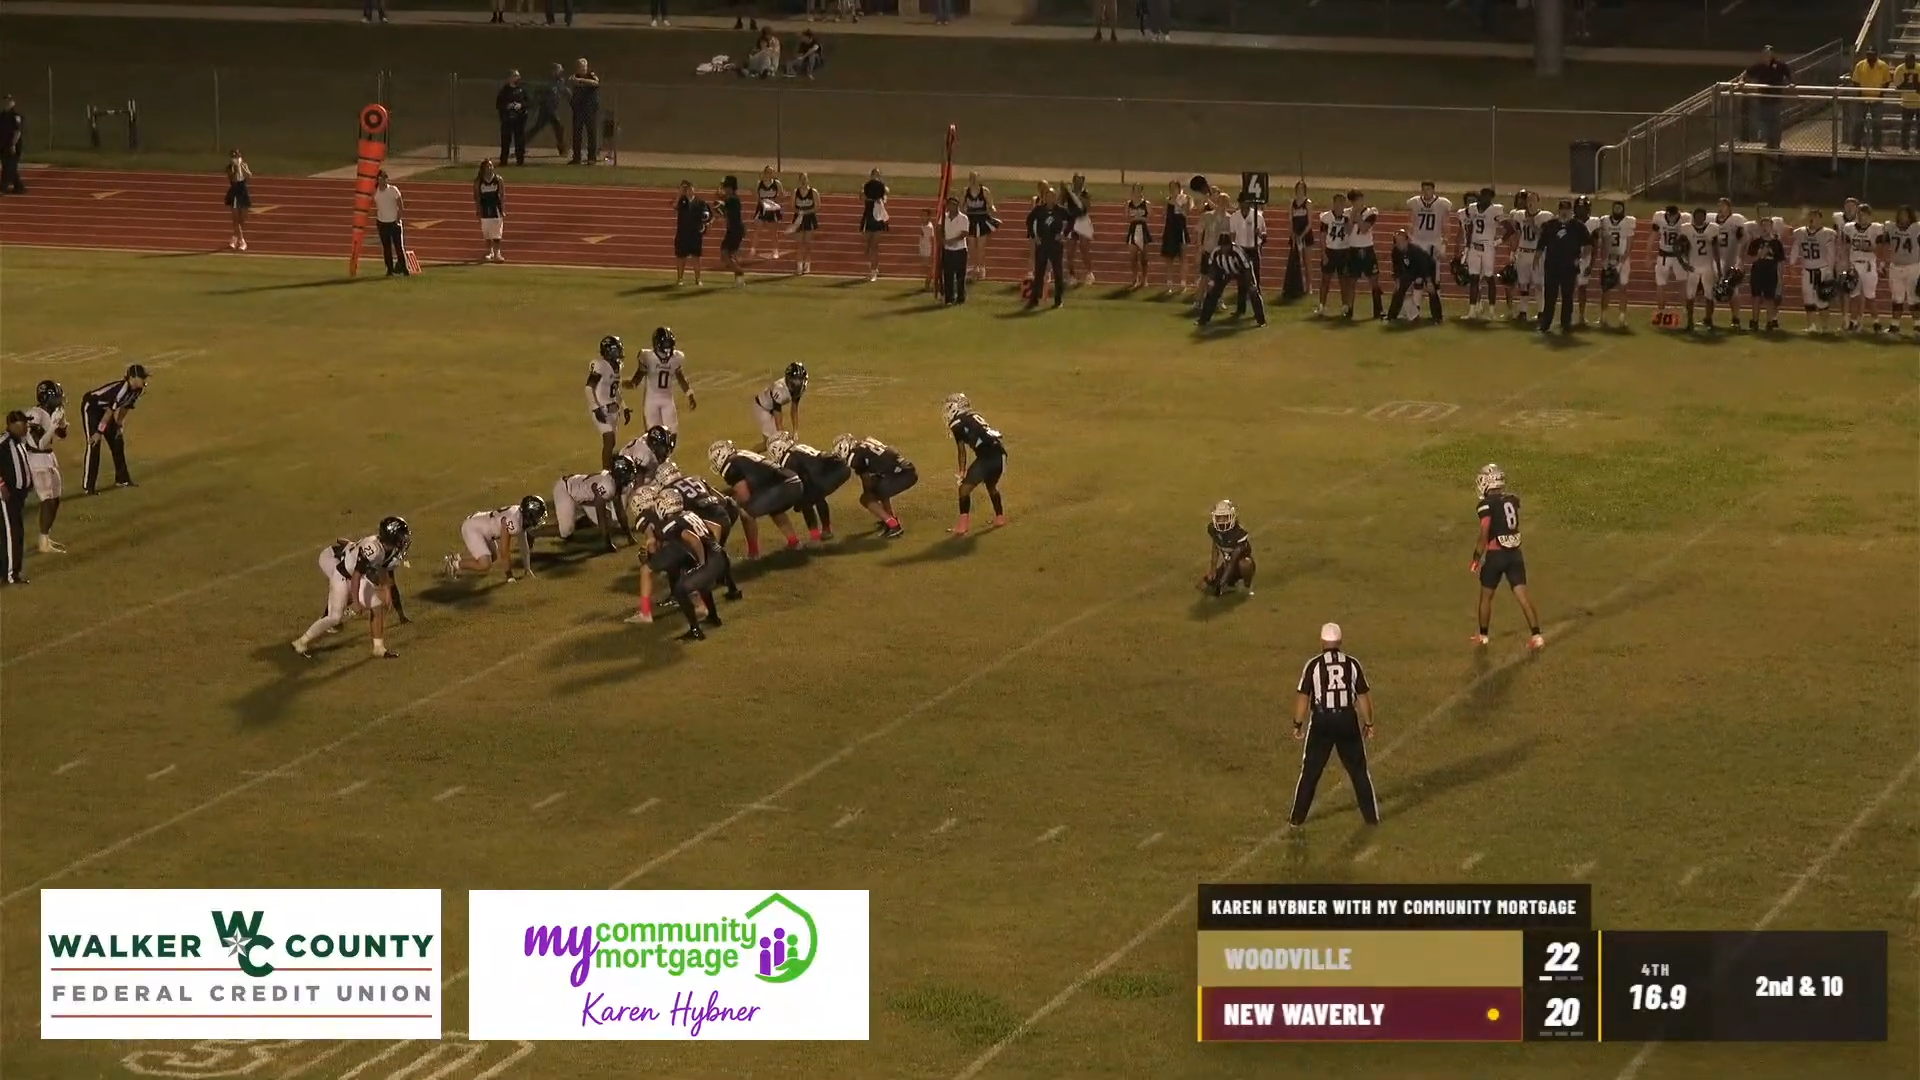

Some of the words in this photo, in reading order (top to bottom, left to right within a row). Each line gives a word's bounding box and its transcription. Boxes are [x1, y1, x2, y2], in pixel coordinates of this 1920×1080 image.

[1248, 175, 1262, 198] 4
[1418, 213, 1436, 231] 70
[1476, 219, 1485, 235] 9
[1330, 226, 1346, 241] 44
[1523, 224, 1536, 242] 10
[1611, 231, 1620, 247] 3
[1663, 230, 1679, 246] 18
[1696, 239, 1707, 256] 2
[1801, 242, 1820, 259] 56
[1891, 237, 1912, 254] 74
[658, 370, 670, 389] 0
[673, 476, 706, 499] 55
[1503, 501, 1517, 530] 8
[1327, 665, 1346, 690] R
